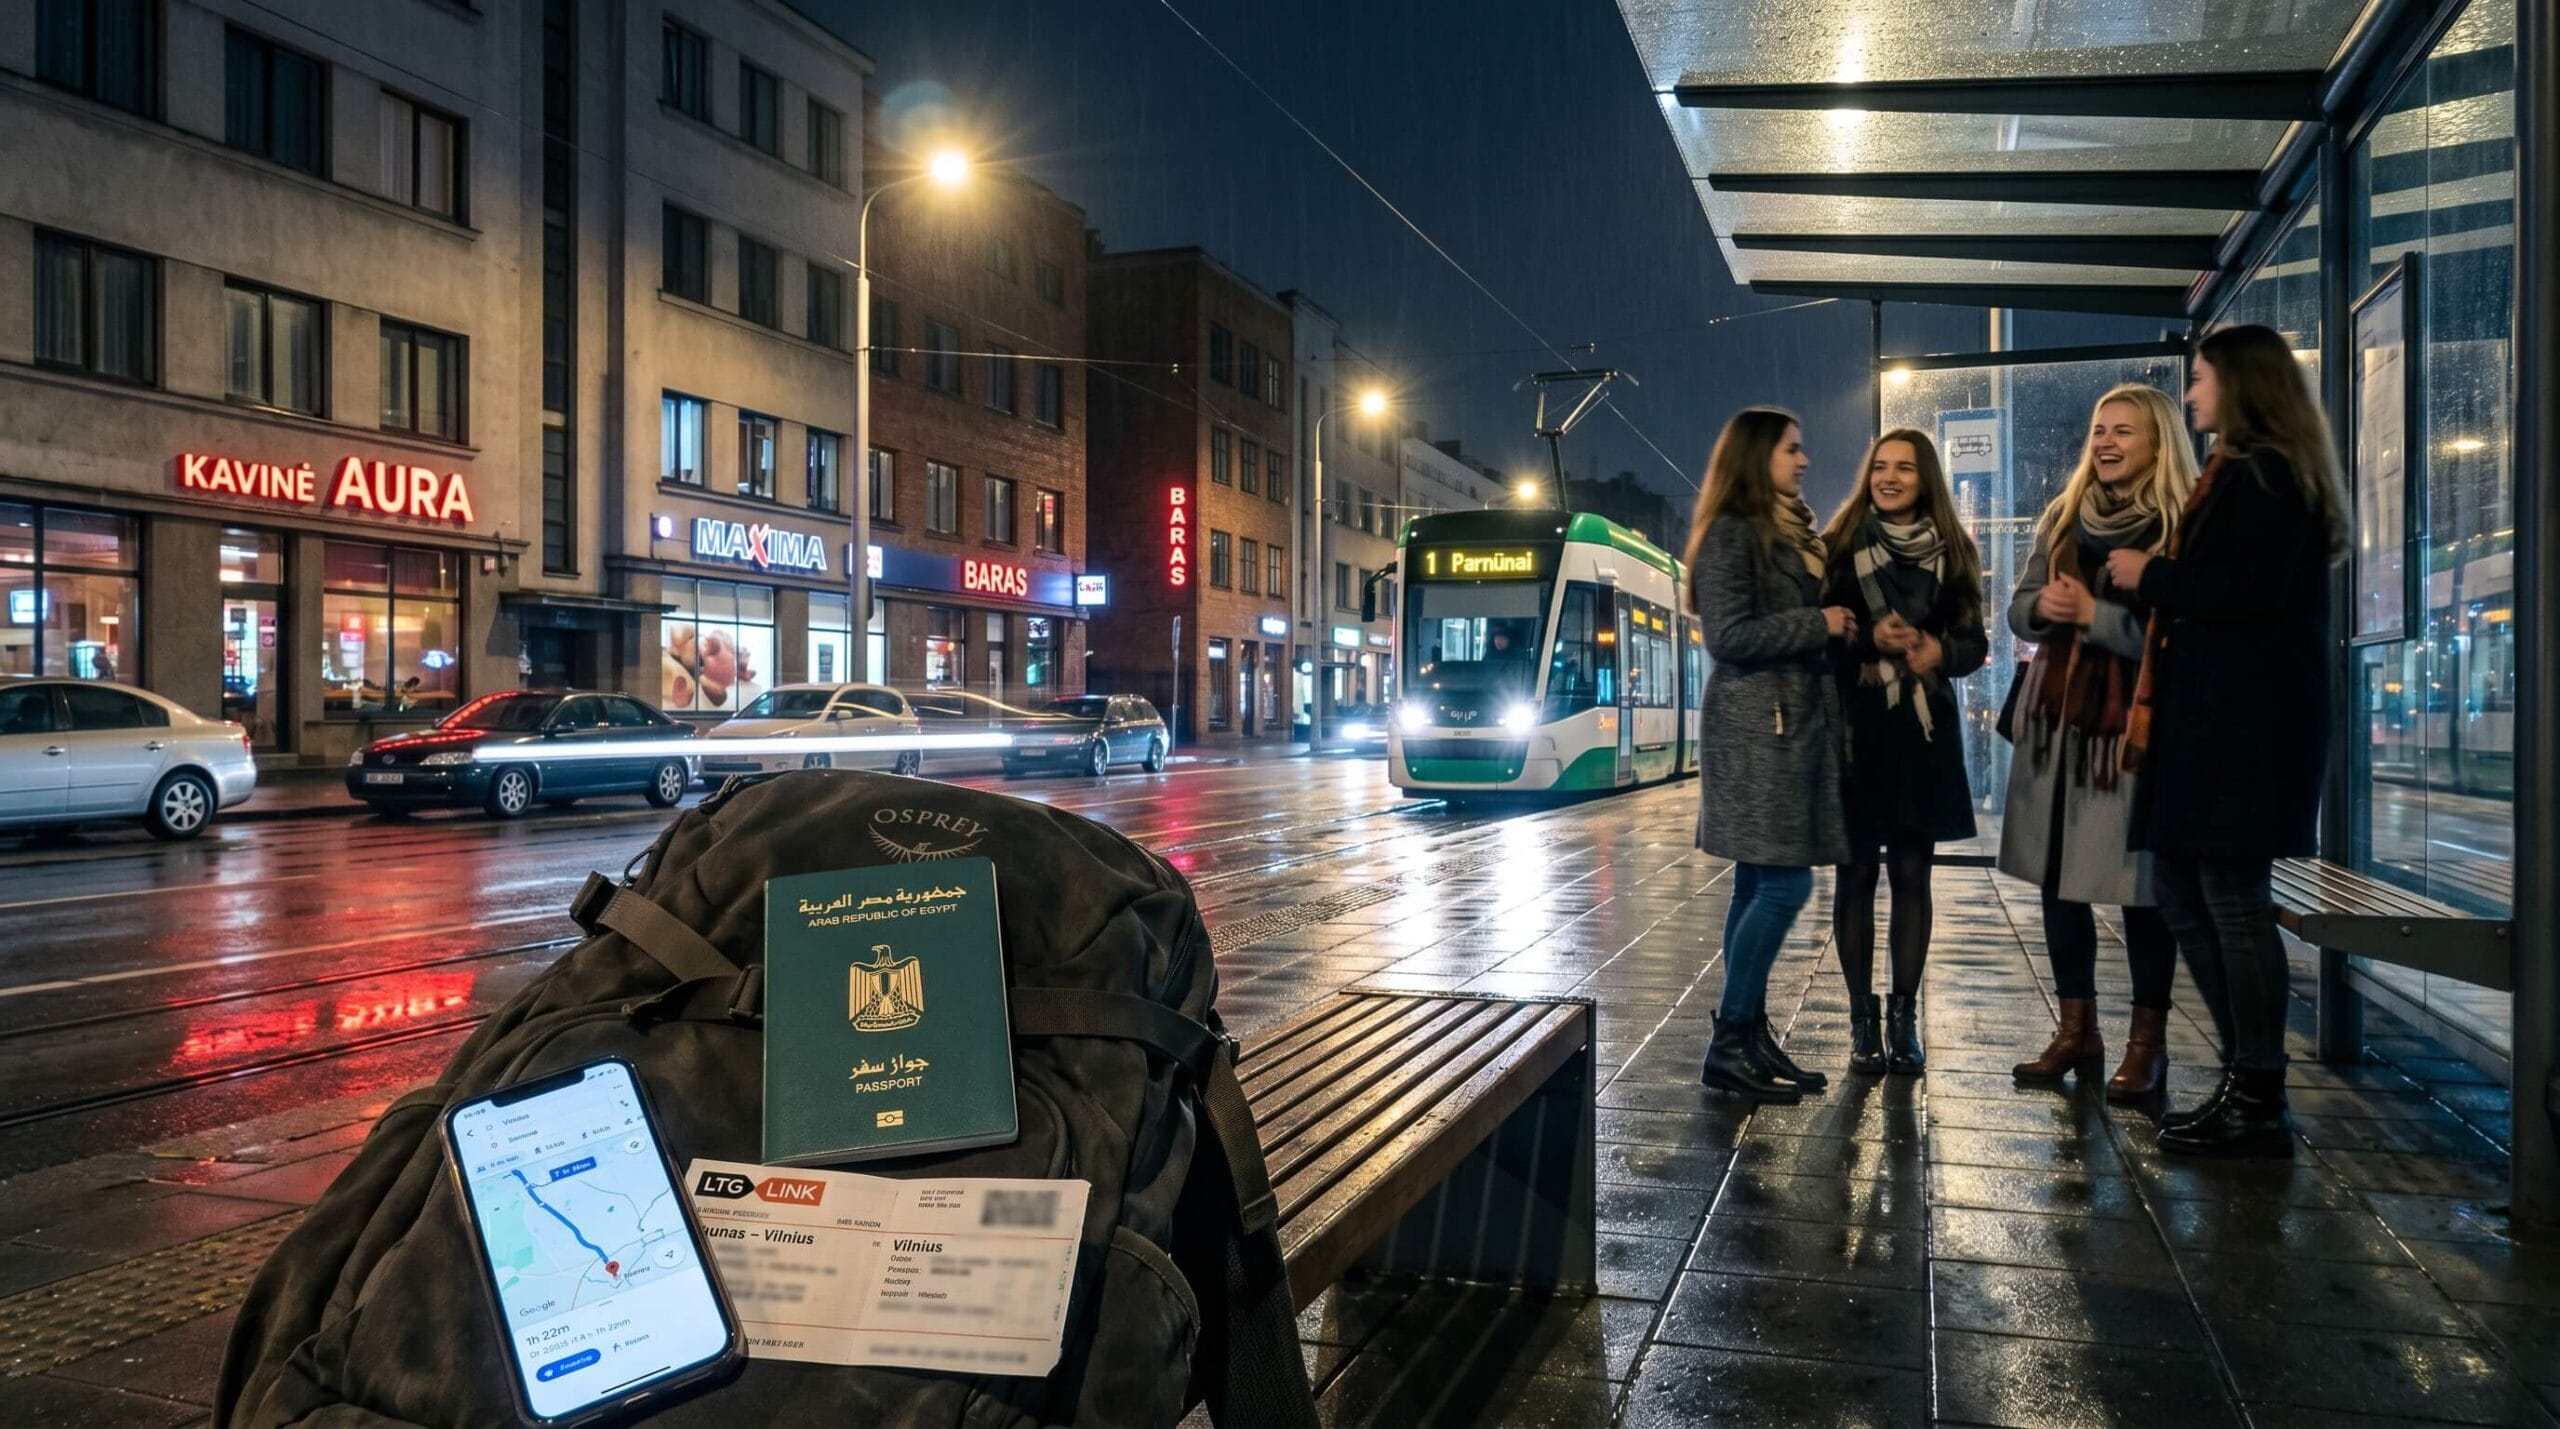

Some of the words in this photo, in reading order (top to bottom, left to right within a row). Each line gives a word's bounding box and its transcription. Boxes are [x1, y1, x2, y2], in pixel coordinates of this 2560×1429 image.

[182, 453, 316, 502] KAVINĖ
[332, 456, 475, 522] AURA
[695, 517, 828, 572] MAXIMA
[1169, 487, 1187, 586] BARAS
[1426, 551, 1436, 575] 1
[1451, 550, 1533, 574] Parnūnai
[964, 560, 1028, 597] BARAS
[874, 808, 989, 838] OSPREY
[857, 896, 894, 910] مصر
[808, 916, 840, 928] ARAB
[842, 909, 899, 924] REPUBLIC
[900, 907, 917, 917] OF
[919, 903, 958, 915] EGYPT
[848, 1059, 885, 1080] سفر
[889, 1053, 930, 1076] جواز
[855, 1075, 923, 1094] PASSPORT
[703, 1176, 745, 1194] LTG
[766, 1181, 818, 1200] LINK
[764, 1229, 815, 1246] Vilnius
[893, 1239, 944, 1253] Vilnius
